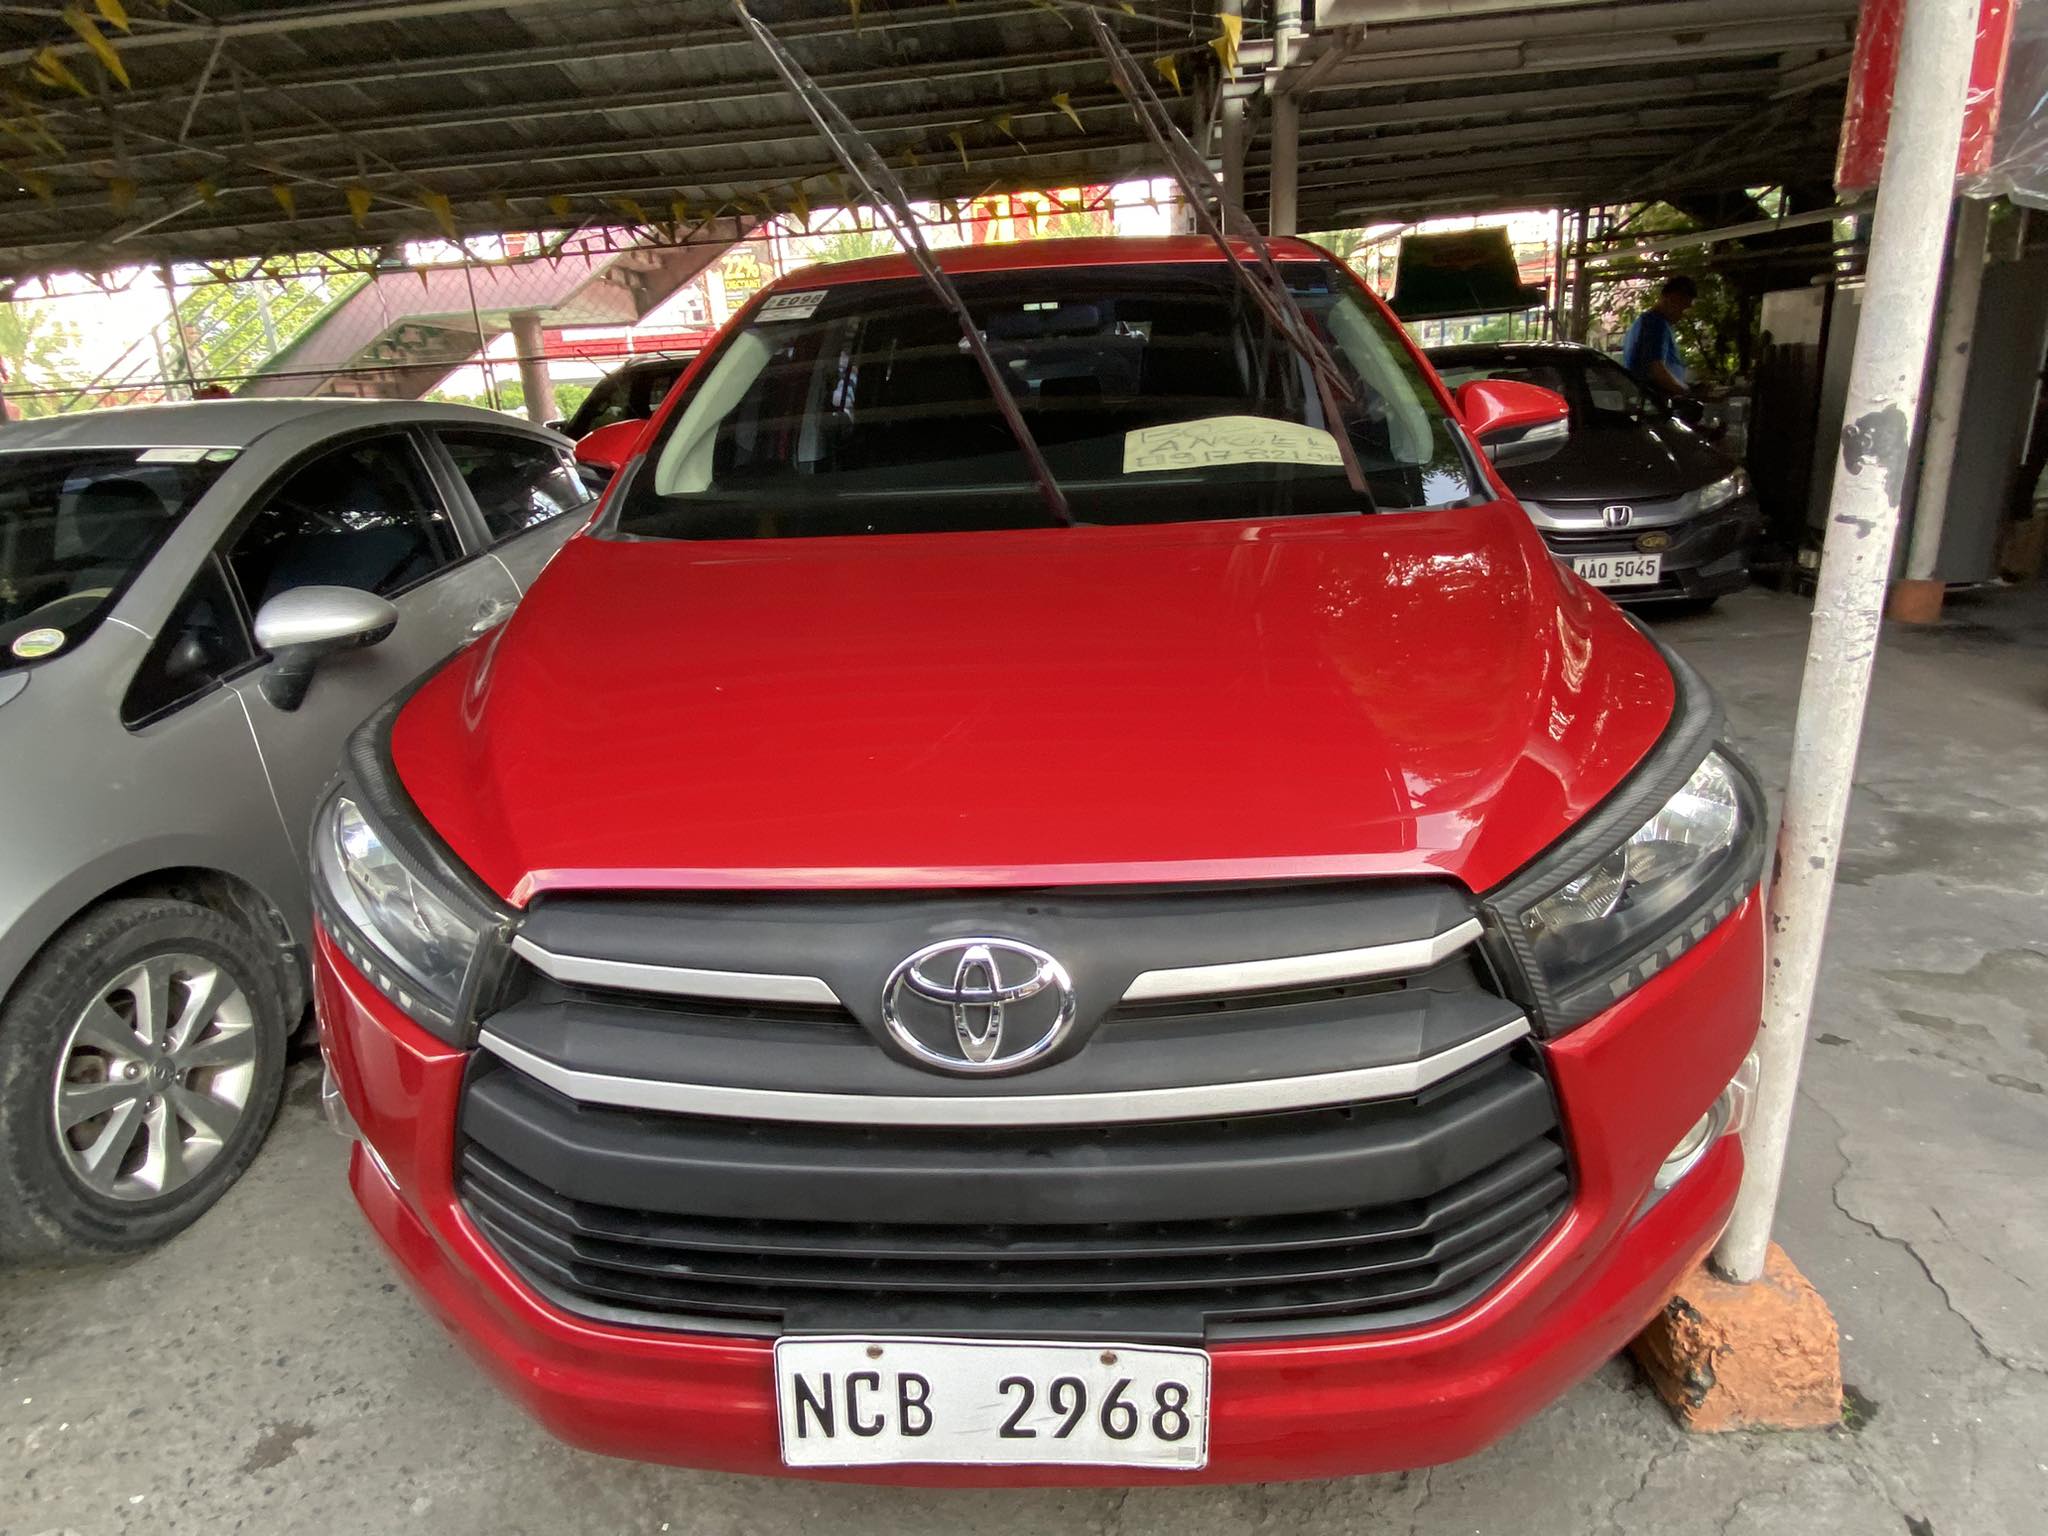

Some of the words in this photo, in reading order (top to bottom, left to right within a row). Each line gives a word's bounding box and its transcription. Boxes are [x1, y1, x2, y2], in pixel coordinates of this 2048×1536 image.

[1580, 562, 1608, 579] AAQ
[1615, 560, 1656, 577] 5045
[794, 1371, 933, 1438] NCB
[999, 1376, 1190, 1441] 2968
